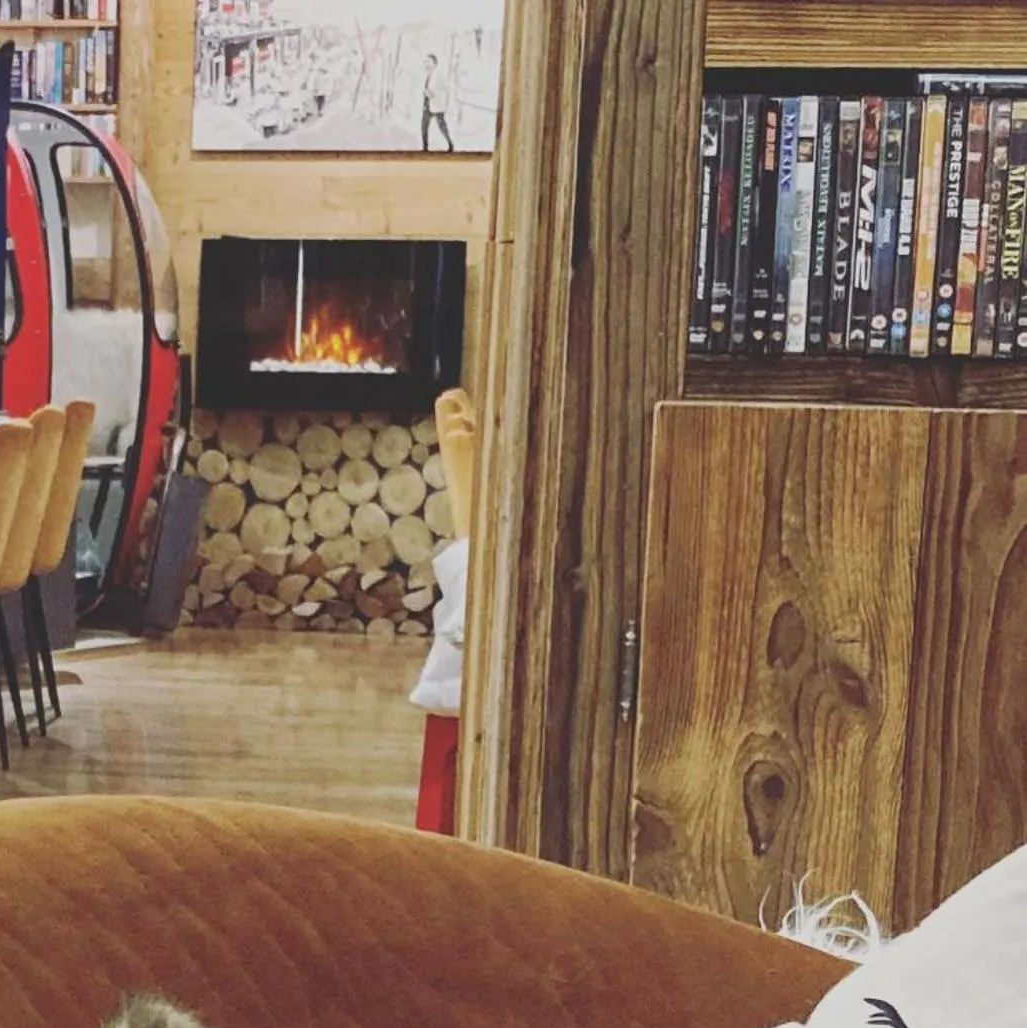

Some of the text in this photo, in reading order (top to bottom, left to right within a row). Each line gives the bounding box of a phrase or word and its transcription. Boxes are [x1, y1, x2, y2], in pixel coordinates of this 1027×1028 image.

[946, 108, 963, 218] THE PRESTIGE
[1007, 165, 1027, 212] MAN
[833, 191, 850, 301] BLADE
[984, 181, 1001, 285] COLLATERAL
[1001, 228, 1021, 279] FIRE
